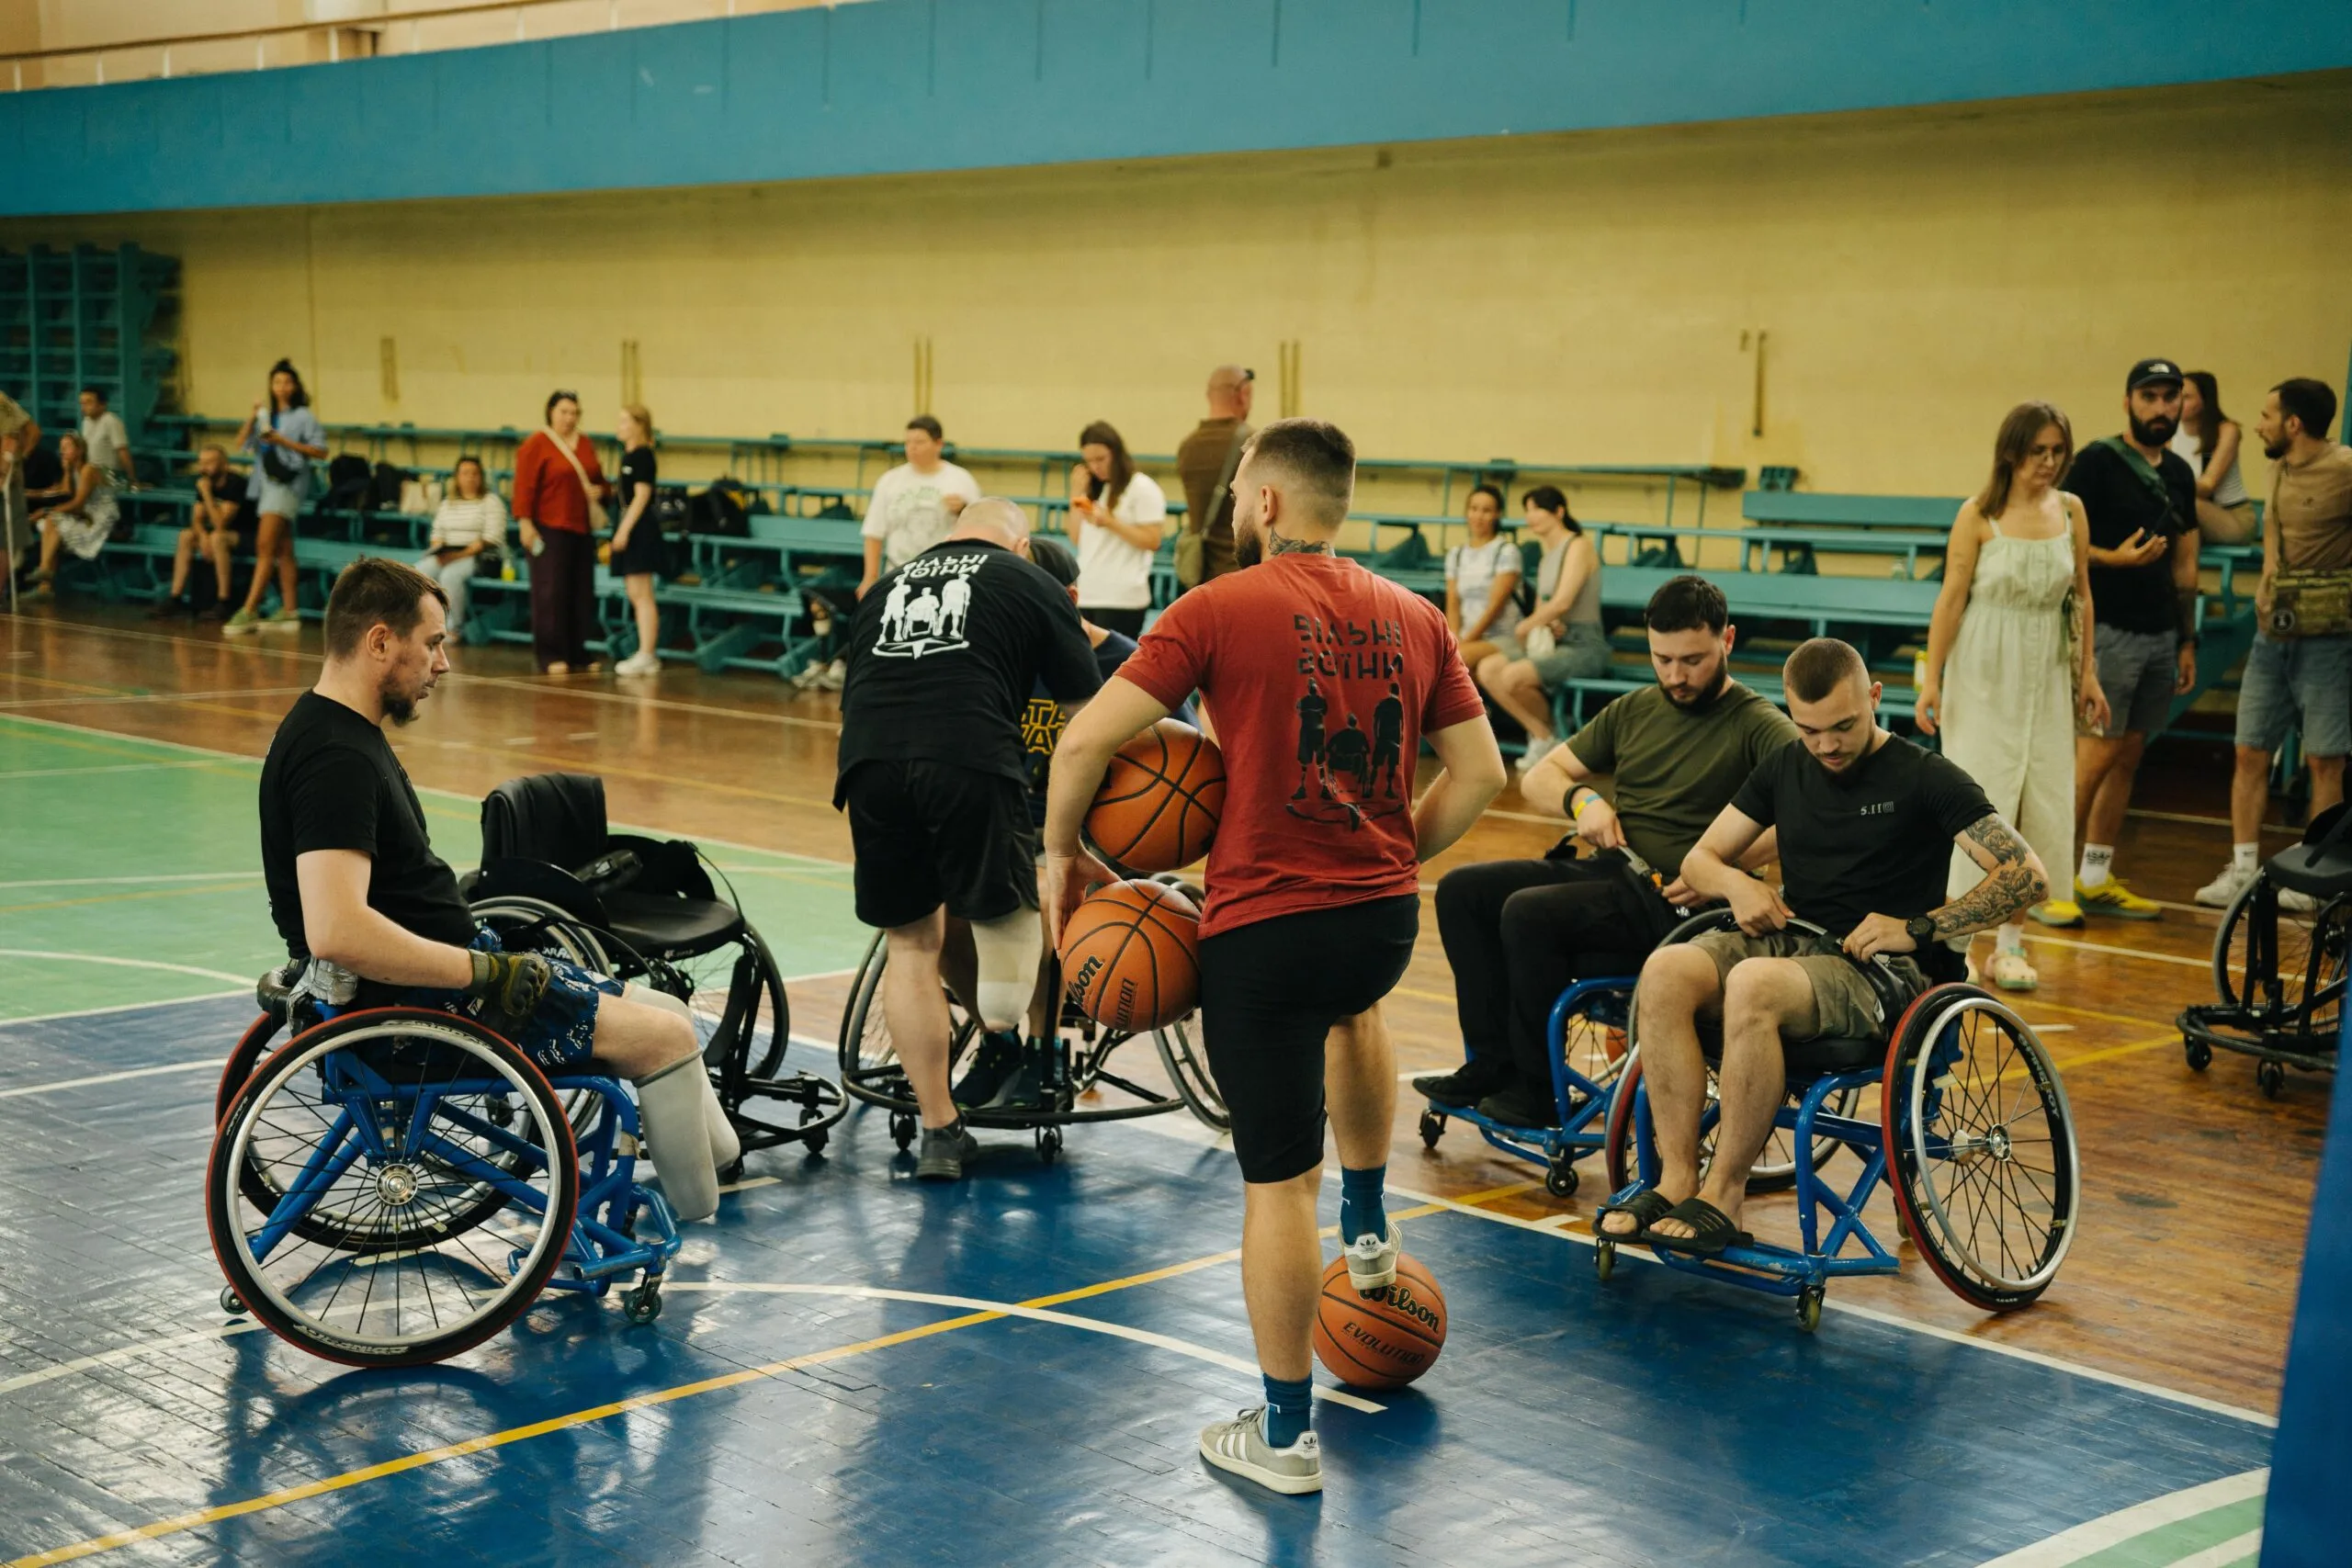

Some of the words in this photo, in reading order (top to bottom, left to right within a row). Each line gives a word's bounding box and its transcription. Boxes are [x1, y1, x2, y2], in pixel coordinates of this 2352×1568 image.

[1294, 614, 1402, 648] ВІЛЬНІ
[1296, 647, 1404, 680] ВОЇНИ
[1068, 954, 1105, 1006] lson
